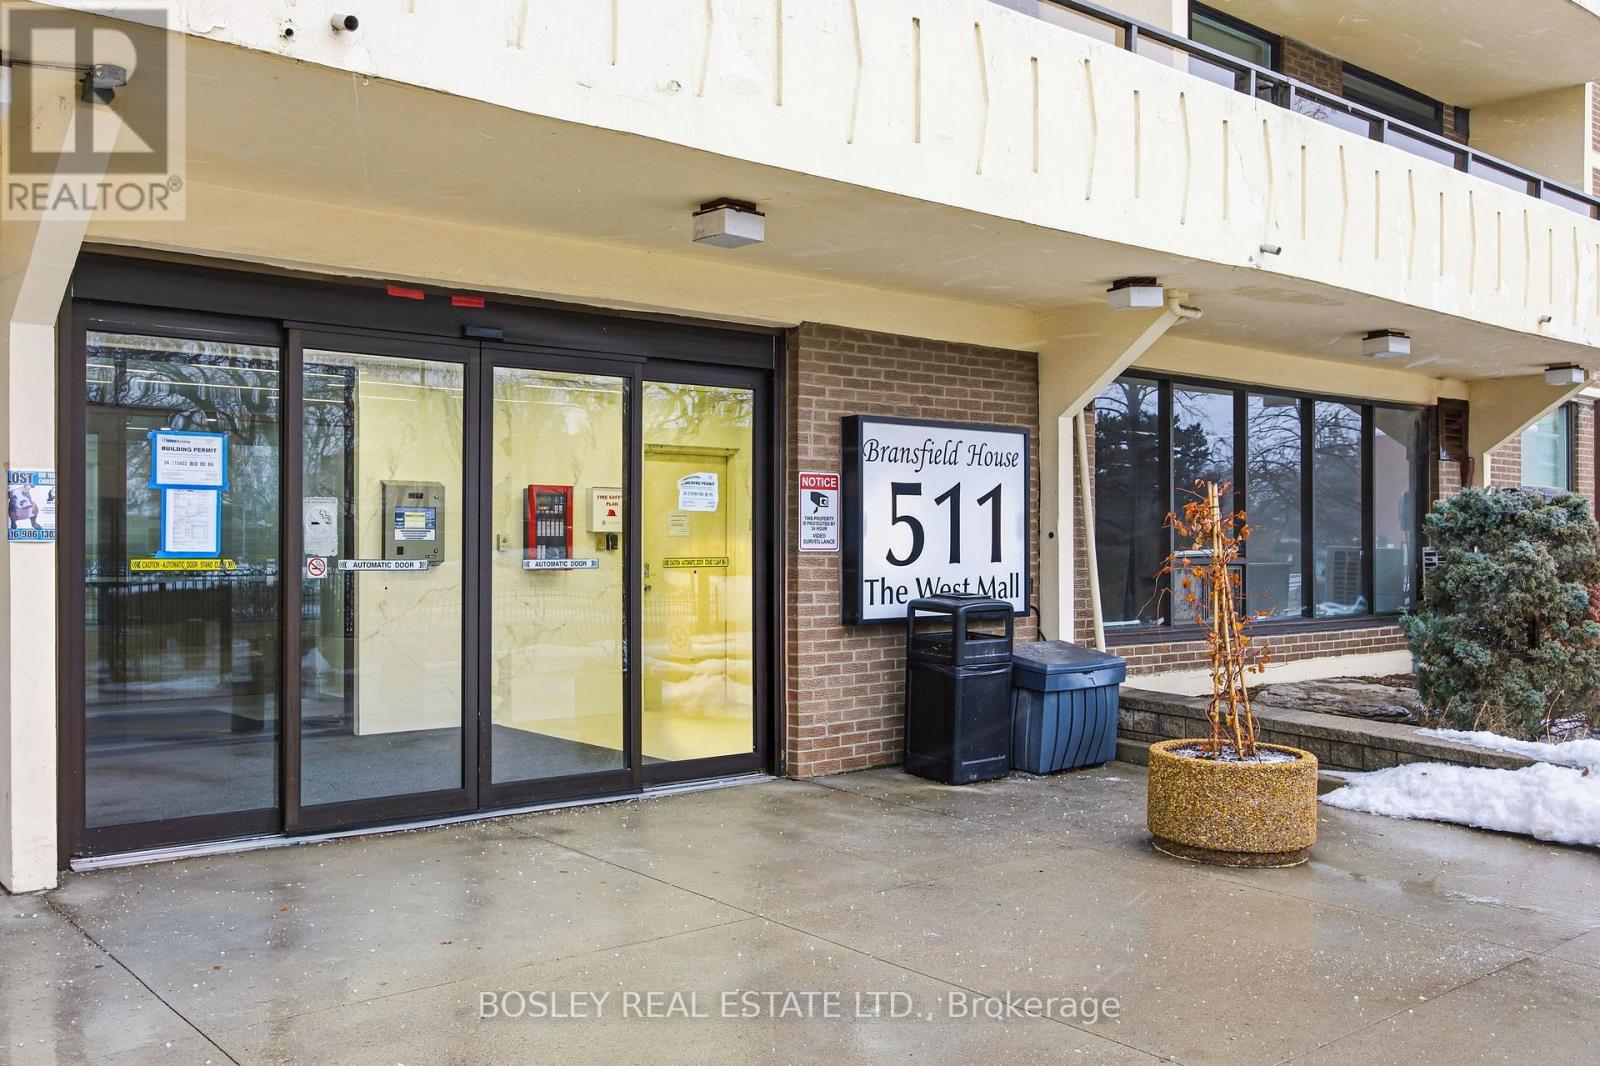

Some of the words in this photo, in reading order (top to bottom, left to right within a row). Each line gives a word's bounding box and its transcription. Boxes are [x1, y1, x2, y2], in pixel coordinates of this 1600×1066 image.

[863, 438, 963, 473] Bransfield
[967, 442, 1020, 468] House
[8, 472, 33, 484] LOST
[802, 476, 837, 488] NOTICE
[21, 530, 38, 538] 986
[885, 481, 1002, 567] 511
[864, 576, 909, 606] The
[915, 576, 971, 599] West
[977, 572, 1020, 600] Mall
